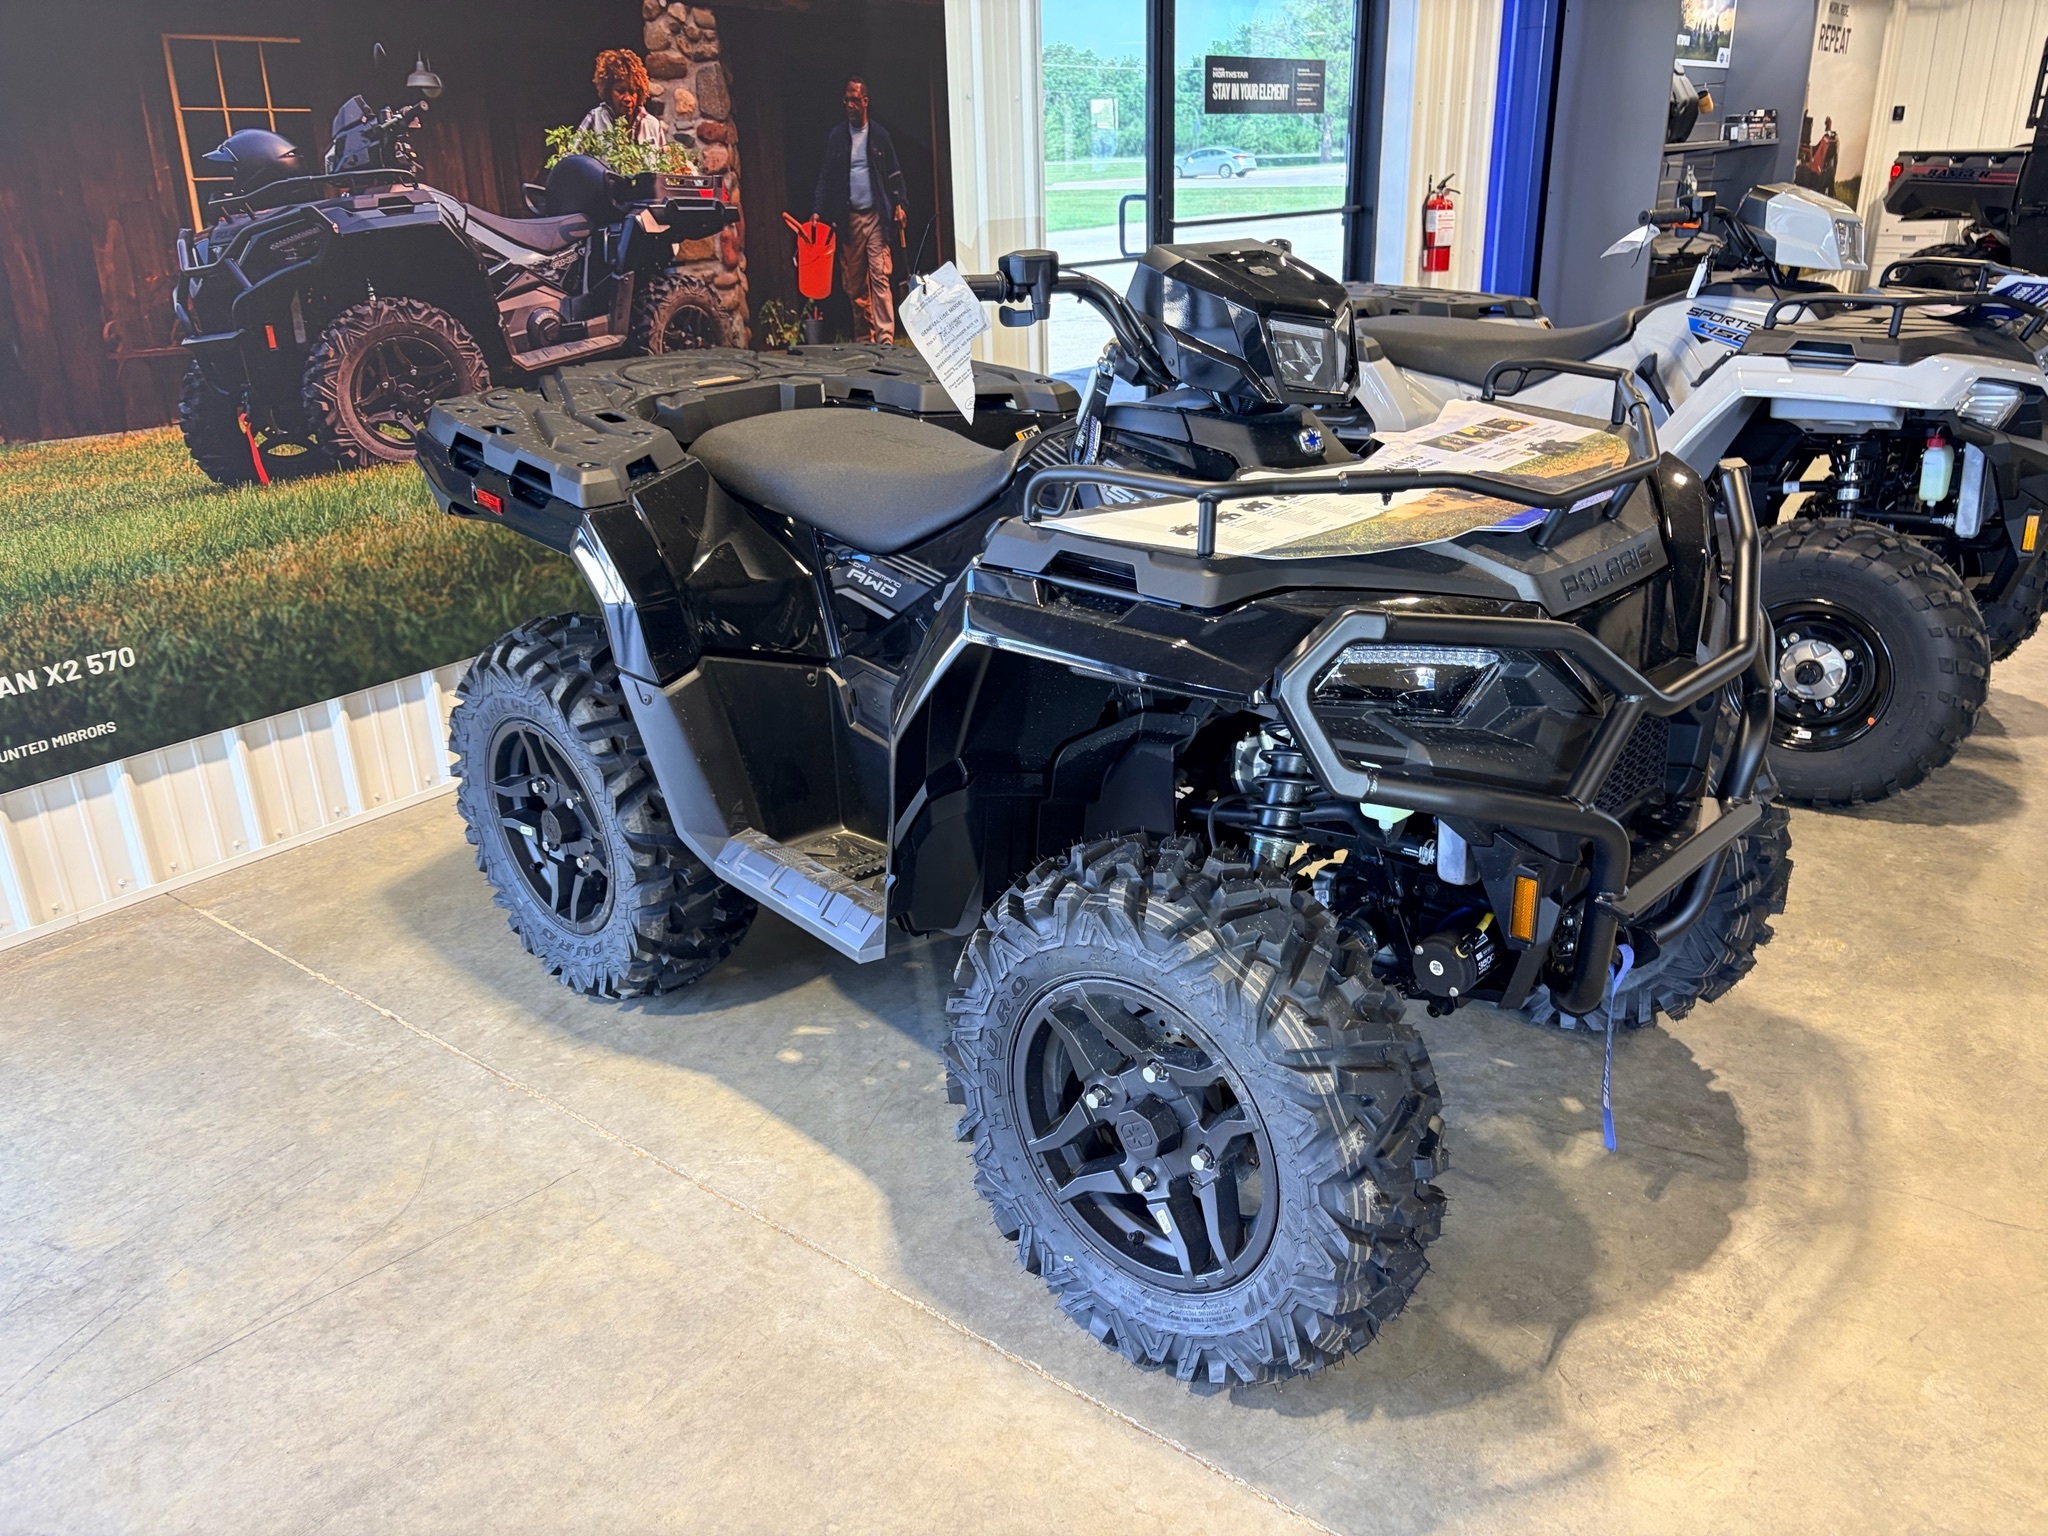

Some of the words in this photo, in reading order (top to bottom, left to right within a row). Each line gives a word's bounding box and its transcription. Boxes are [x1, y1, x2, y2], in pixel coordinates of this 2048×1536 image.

[1818, 23, 1852, 54] REPEAT
[1212, 71, 1249, 79] NORTHSTAR
[1212, 82, 1231, 101] STAY
[1231, 83, 1240, 101] IN
[1240, 83, 1259, 101] YOUR
[1259, 83, 1290, 101] ELEMENT
[948, 299, 964, 314] MODEL
[846, 568, 898, 598] AWD
[852, 561, 866, 571] ON
[868, 569, 902, 588] DEMAND
[1560, 542, 1653, 602] POLARIS
[42, 659, 82, 687] X2
[86, 646, 136, 675] 570
[51, 721, 117, 749] MIRRORS
[539, 926, 603, 960] DURO
[984, 975, 1030, 1093] DURO
